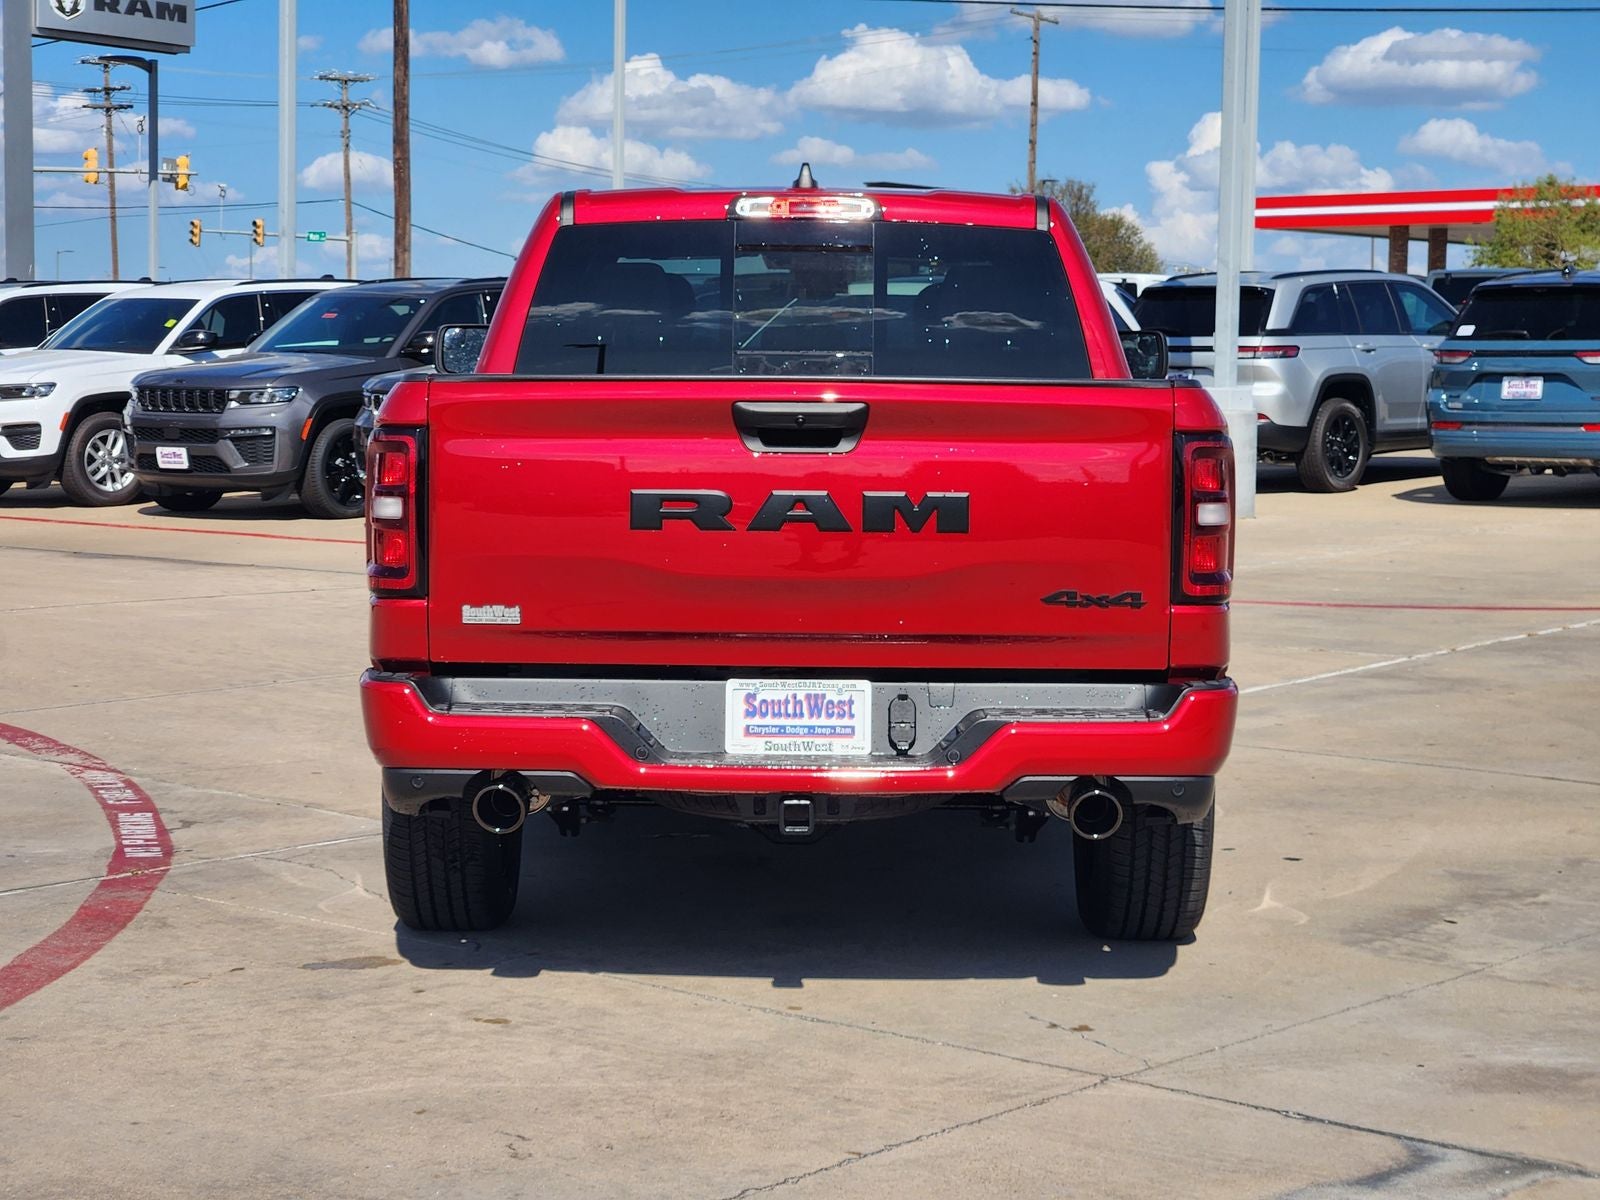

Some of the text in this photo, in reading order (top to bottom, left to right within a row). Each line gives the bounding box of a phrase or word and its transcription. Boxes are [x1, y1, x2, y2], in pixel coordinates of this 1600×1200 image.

[94, 0, 187, 23] RAM
[630, 489, 970, 533] RAM
[1040, 590, 1148, 609] 4x4
[743, 692, 856, 720] SouthWest
[749, 725, 853, 736] Chrysler Dodge Jeep Ram
[764, 740, 834, 752] SouthWest
